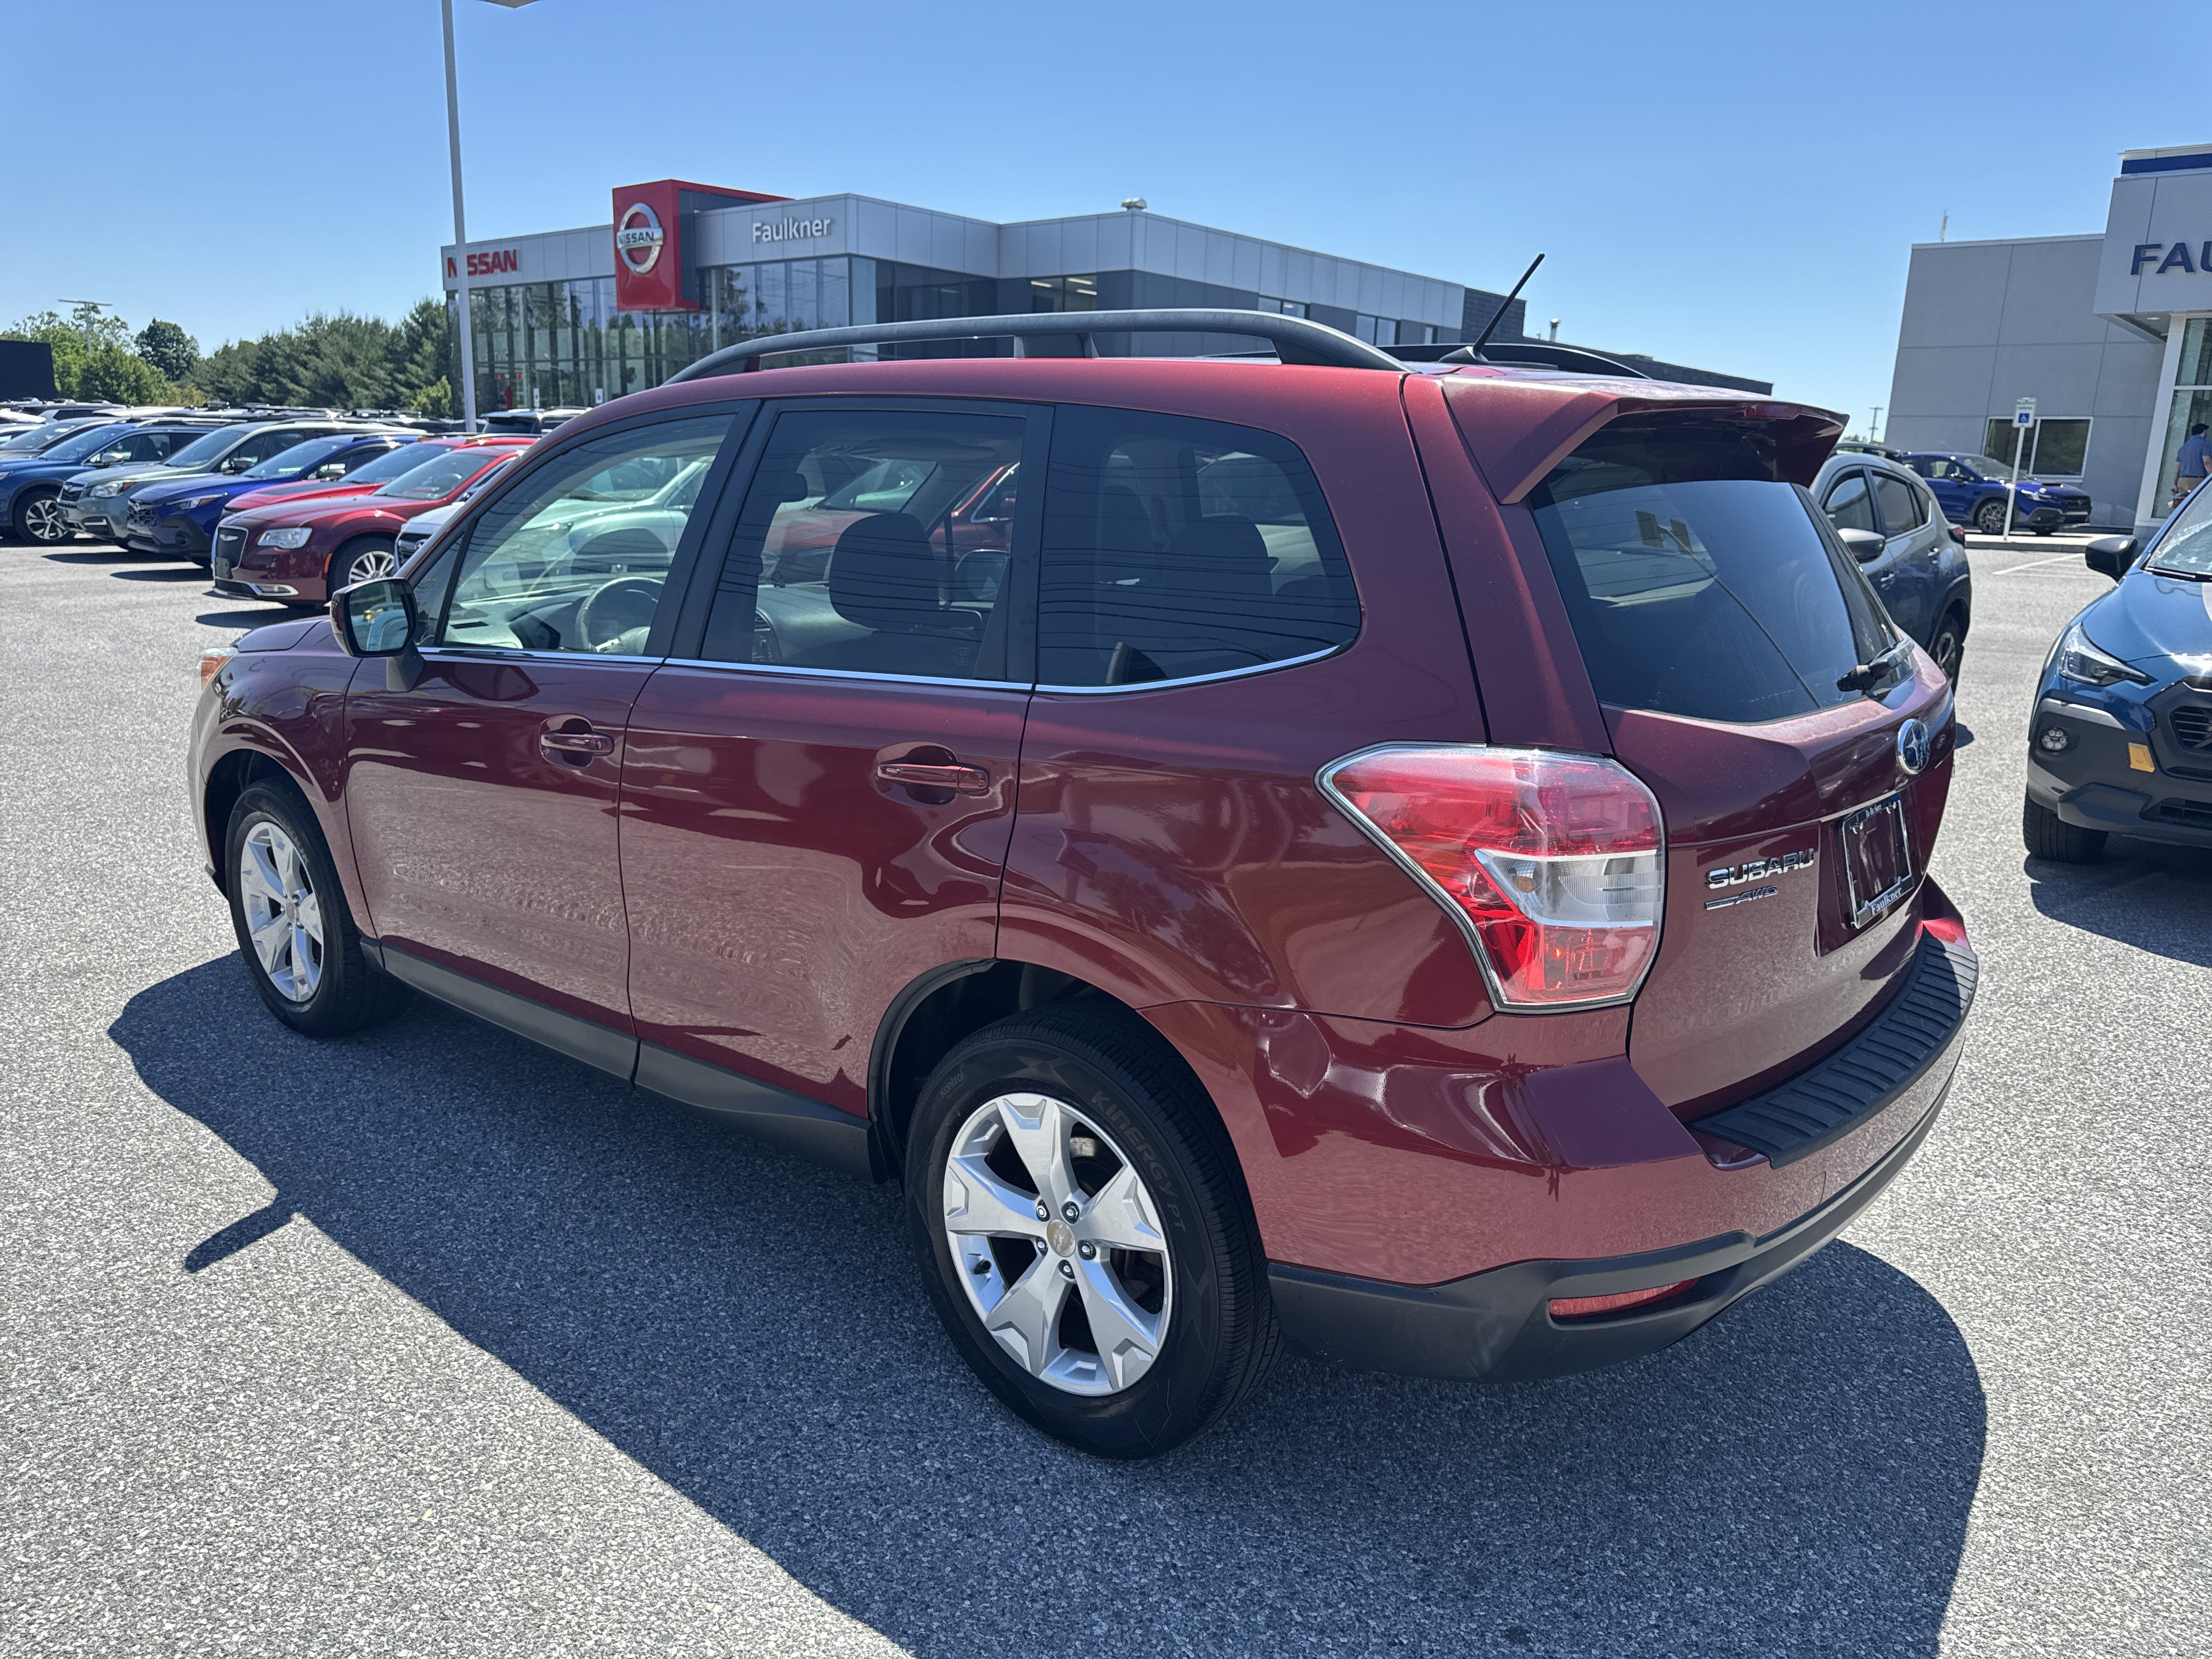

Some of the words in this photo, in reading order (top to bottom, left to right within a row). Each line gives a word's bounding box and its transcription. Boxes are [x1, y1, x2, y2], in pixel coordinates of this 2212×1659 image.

[618, 231, 654, 245] NISSAN
[753, 217, 831, 243] Faulkner
[448, 249, 517, 278] NSSAN
[1708, 848, 1814, 889] SUBARU
[1870, 887, 1901, 916] Faulkner
[939, 1062, 964, 1098] Kontrol
[1167, 1204, 1185, 1232] PT
